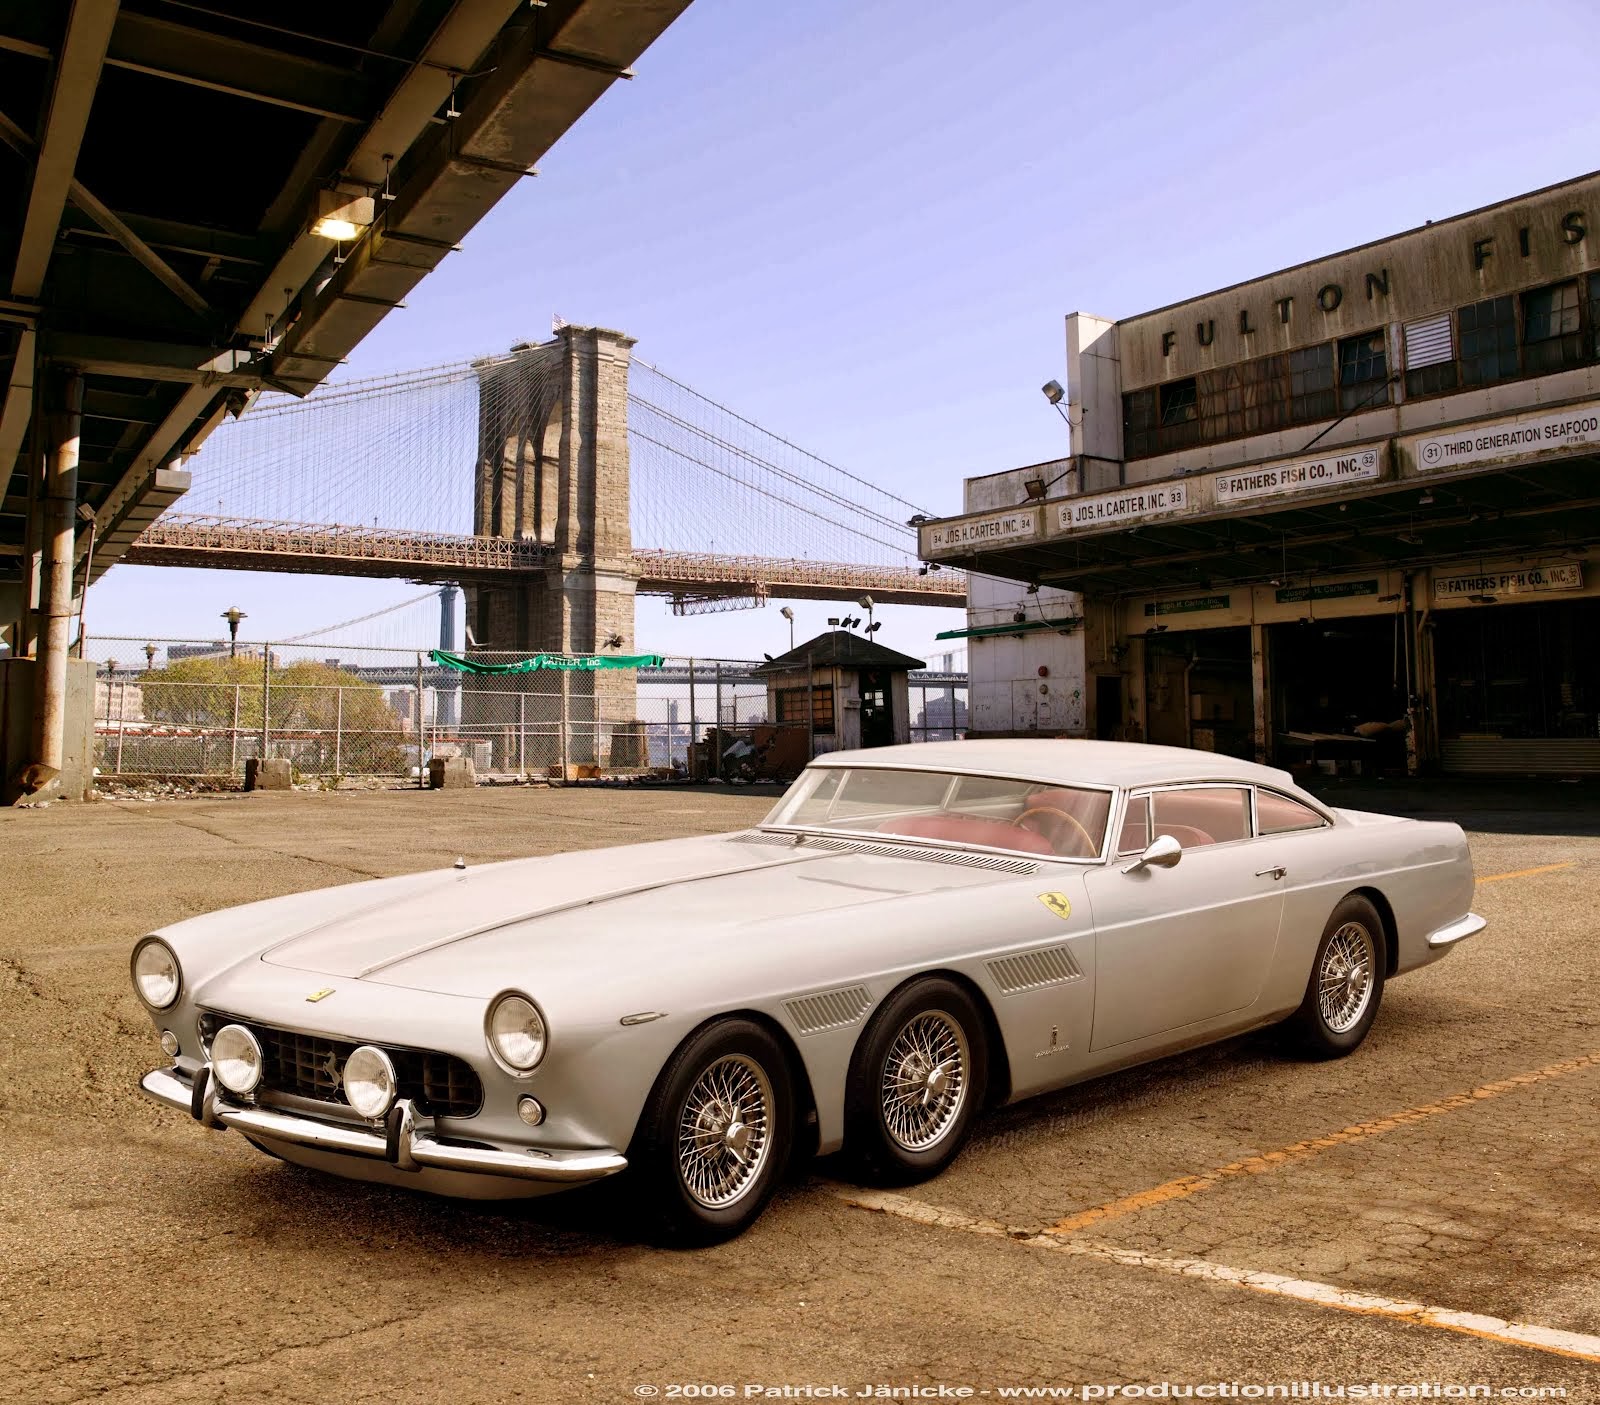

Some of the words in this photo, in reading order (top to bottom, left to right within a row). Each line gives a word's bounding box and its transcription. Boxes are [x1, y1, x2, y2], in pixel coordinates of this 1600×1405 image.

[1161, 268, 1389, 357] FULTON
[1473, 210, 1586, 271] FIS
[1444, 440, 1473, 457] THIRD
[1475, 427, 1541, 451] GENERATION
[1544, 417, 1598, 439] SEAFOOD
[1230, 472, 1277, 493] FATHERS
[1280, 467, 1306, 485] FISH
[1337, 458, 1361, 475] INC.
[1148, 493, 1167, 510] INC.
[1448, 577, 1496, 593] FATHERS
[1500, 574, 1525, 588] FISH
[586, 658, 601, 666] Inc.
